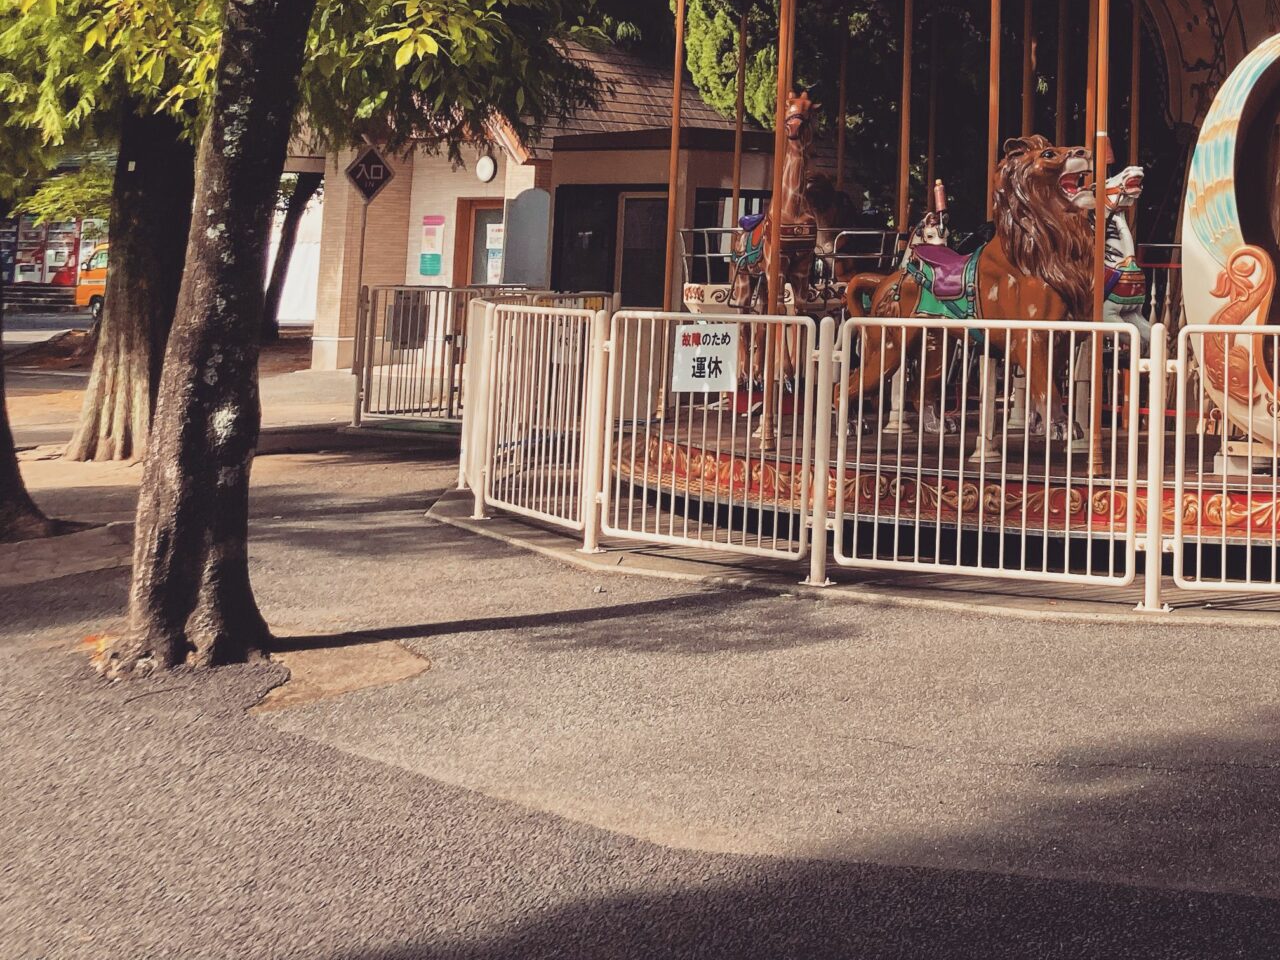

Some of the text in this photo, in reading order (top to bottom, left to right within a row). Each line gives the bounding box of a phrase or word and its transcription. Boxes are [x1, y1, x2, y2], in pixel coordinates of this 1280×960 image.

[356, 163, 384, 180] 入口
[681, 332, 731, 347] 故障のため
[691, 356, 722, 378] 運休
